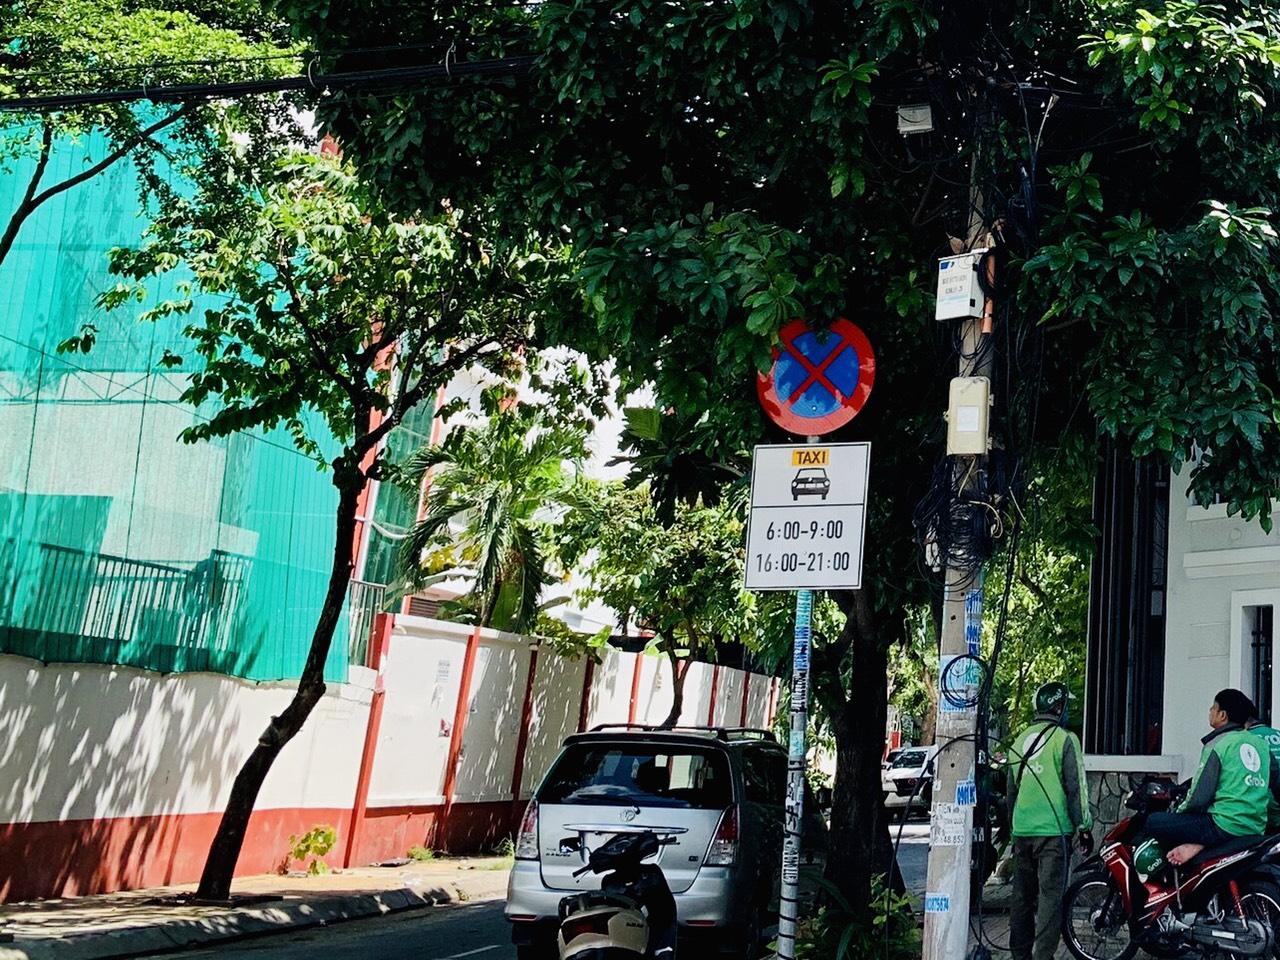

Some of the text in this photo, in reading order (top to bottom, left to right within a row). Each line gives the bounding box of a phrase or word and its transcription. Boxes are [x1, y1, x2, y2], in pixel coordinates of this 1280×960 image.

[796, 451, 826, 464] TAXI
[766, 520, 843, 540] 6:00-9:00
[756, 551, 850, 572] 16:00-21:00
[1244, 773, 1265, 787] Grab
[1147, 858, 1162, 871] Grab
